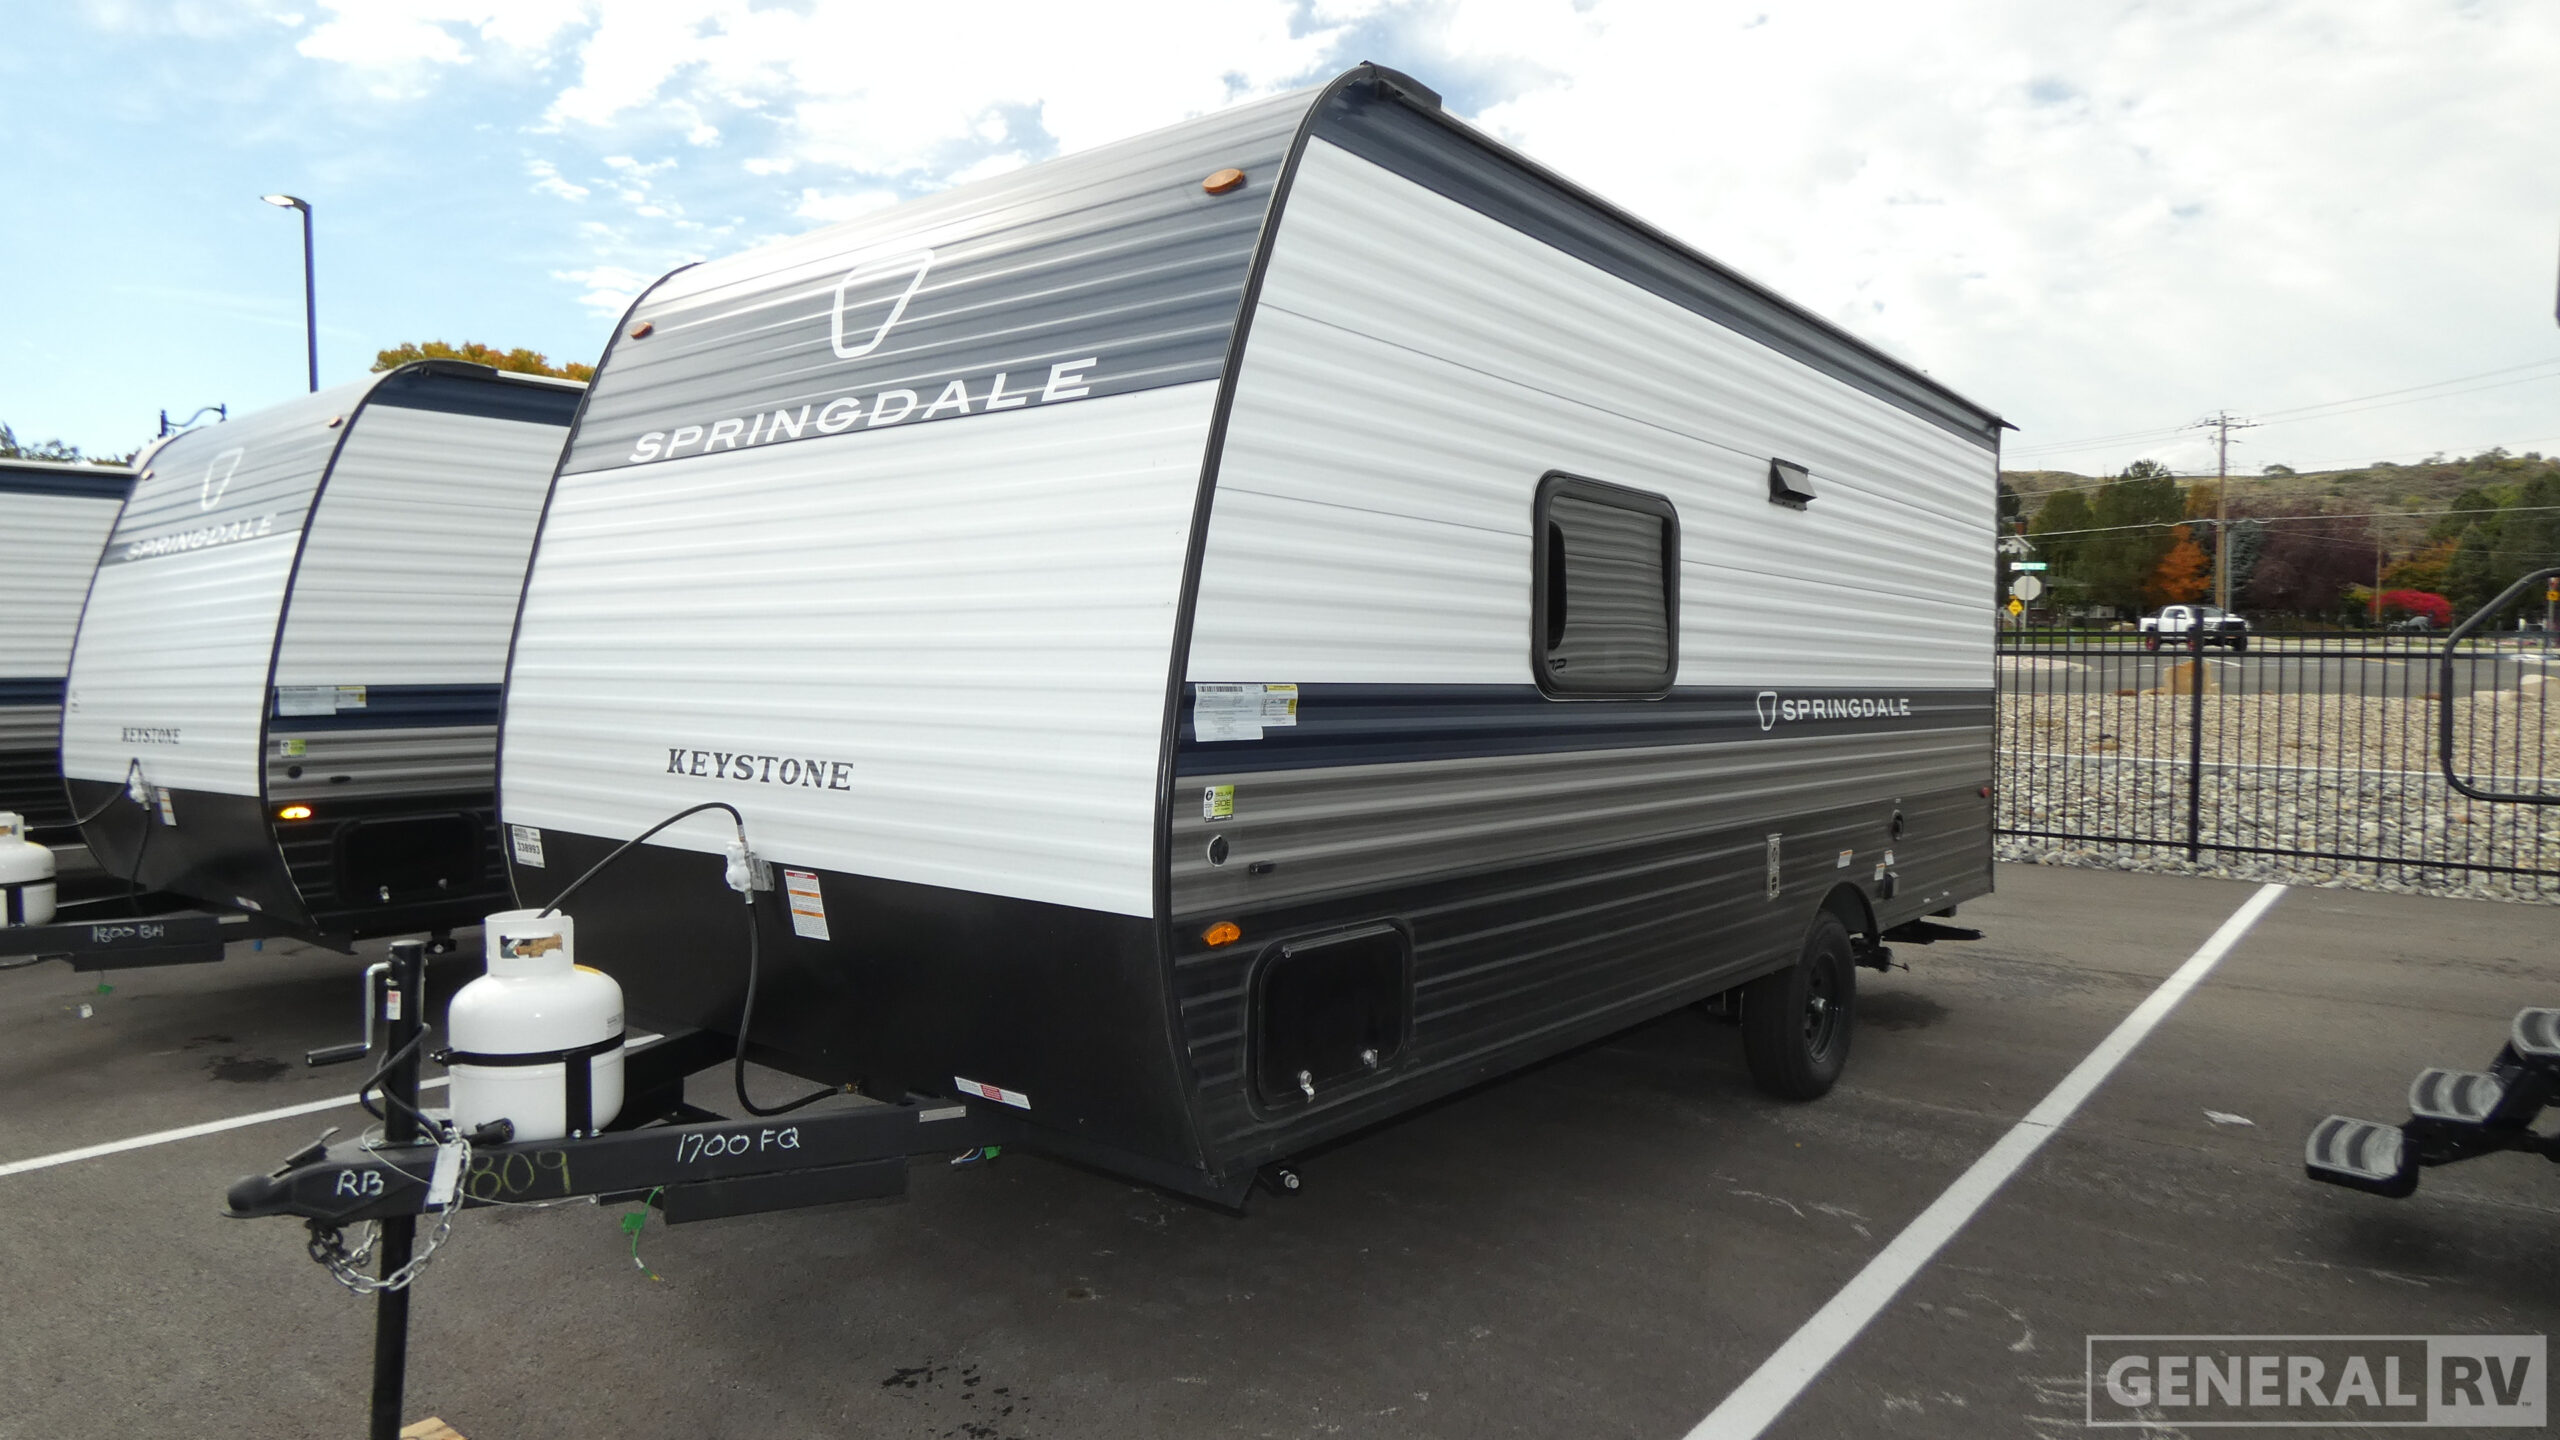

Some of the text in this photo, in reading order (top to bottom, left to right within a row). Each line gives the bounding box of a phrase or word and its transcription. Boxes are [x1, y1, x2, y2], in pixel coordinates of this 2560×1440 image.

[627, 356, 1098, 464] SPRINGDALE
[125, 512, 277, 561] SPRINGDALE
[1781, 698, 1912, 721] SPRINGDALE
[121, 727, 181, 744] KEYSTONE
[666, 748, 854, 791] KEYSTONE
[677, 1127, 800, 1163] 1700 FQ
[336, 1169, 385, 1197] RB
